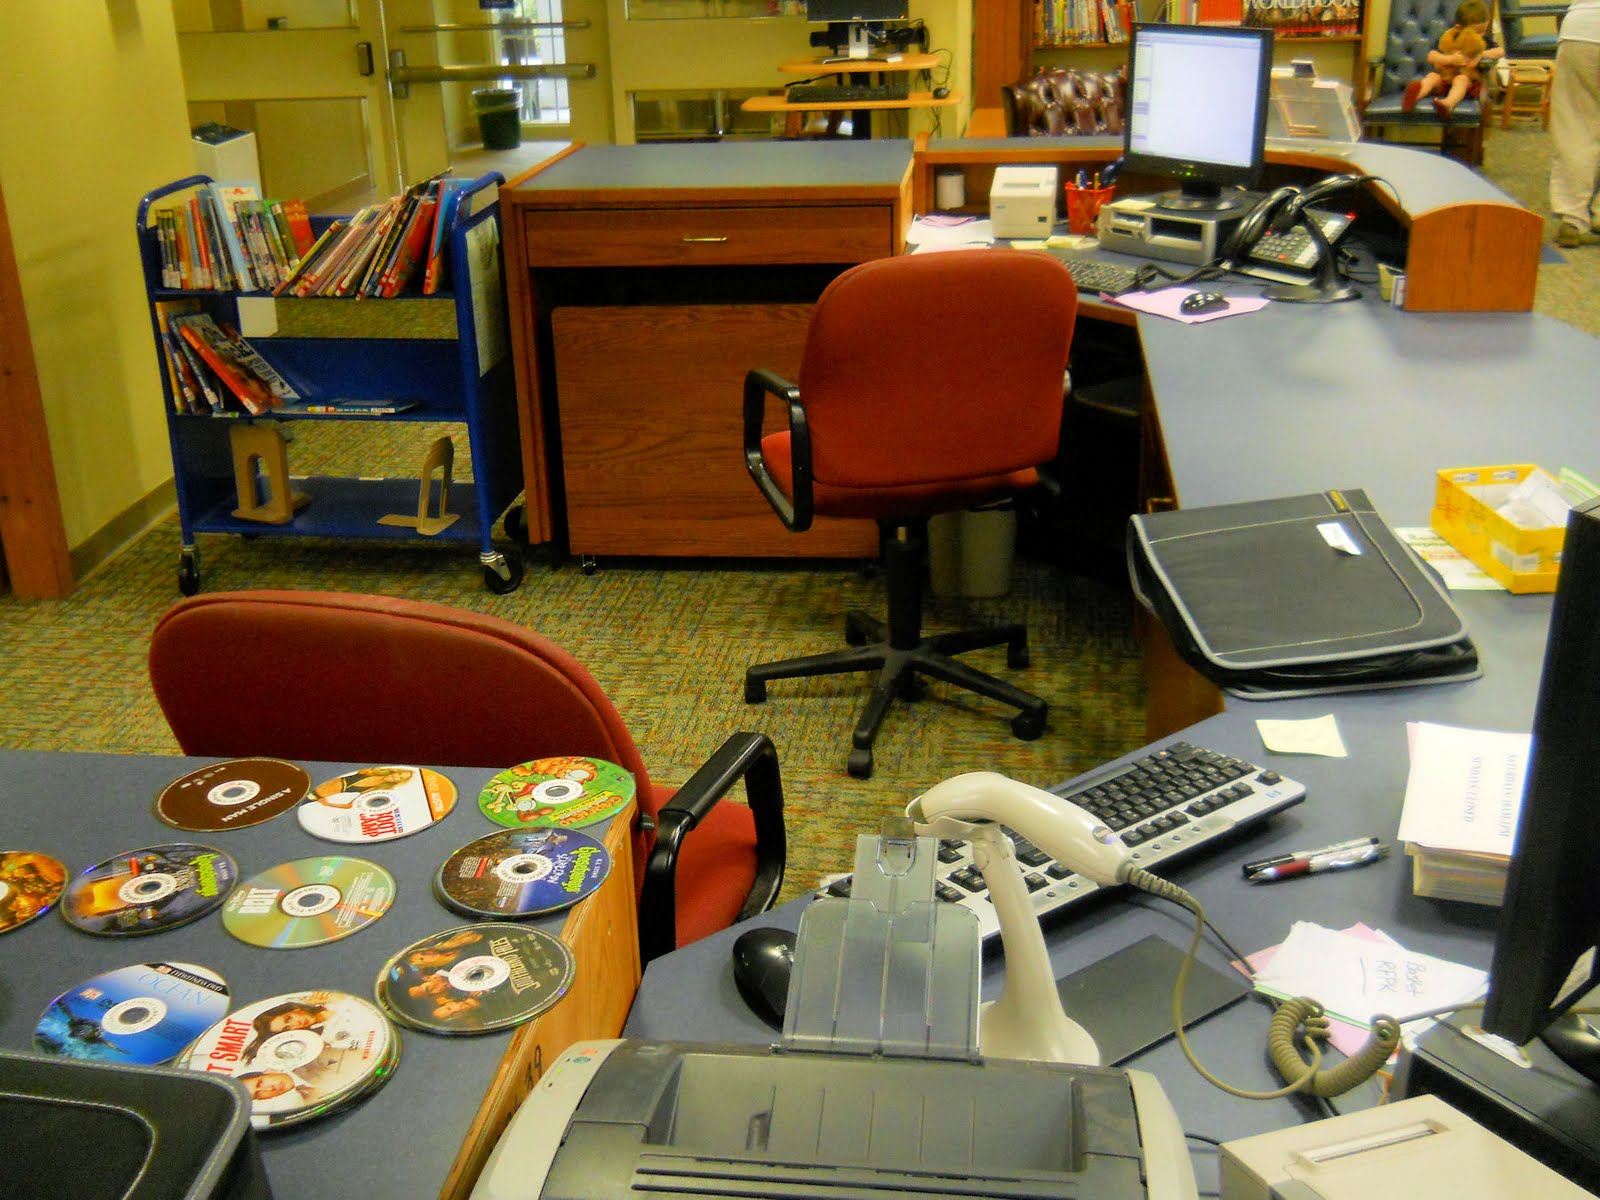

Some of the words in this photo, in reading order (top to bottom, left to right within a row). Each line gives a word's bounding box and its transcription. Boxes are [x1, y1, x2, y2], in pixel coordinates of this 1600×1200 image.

[221, 808, 249, 823] MAN
[246, 791, 284, 811] SINGLE
[561, 846, 601, 893] Goosebumps
[209, 1018, 253, 1062] SMART
